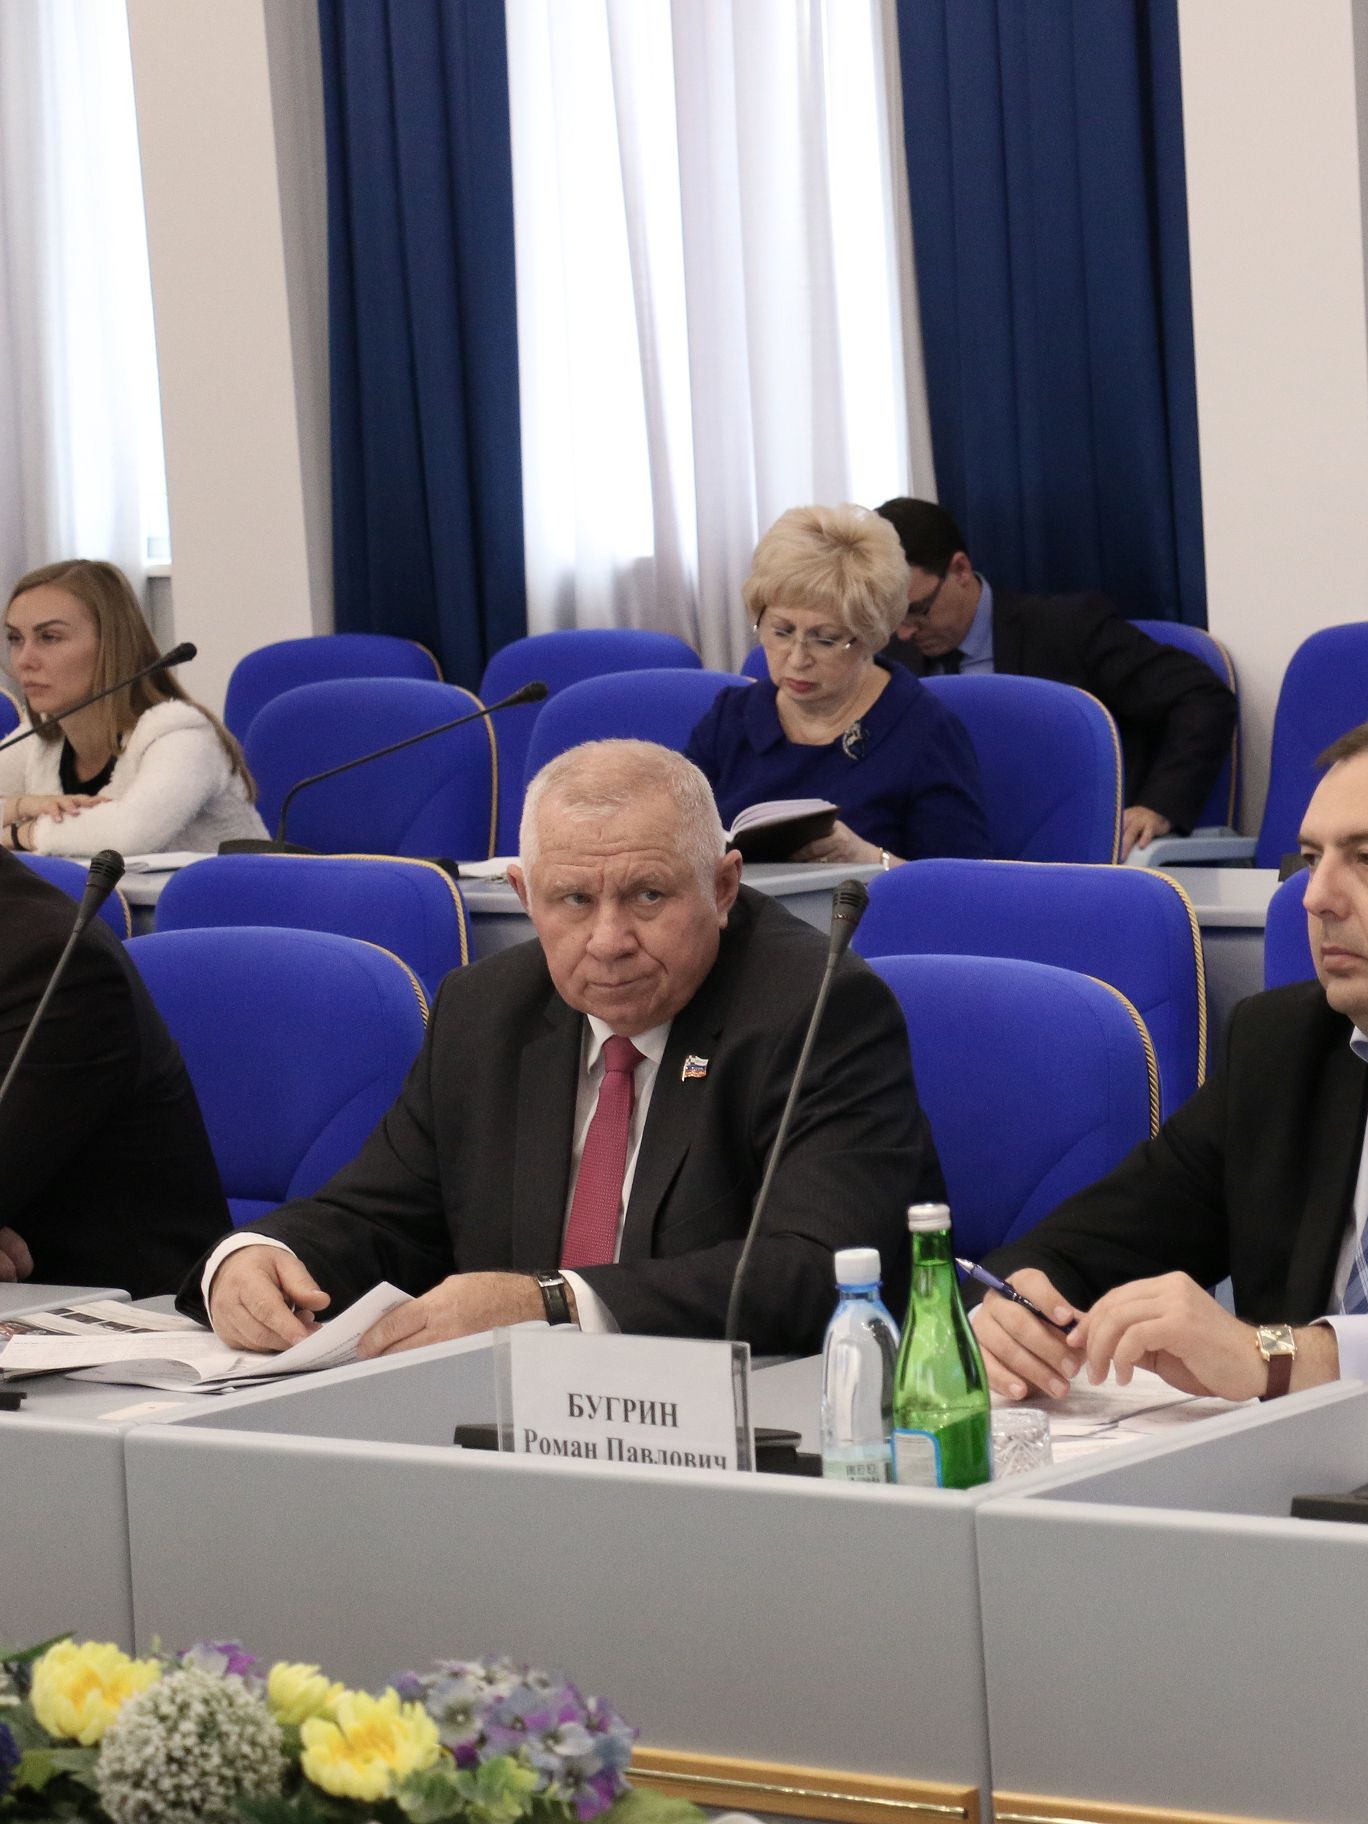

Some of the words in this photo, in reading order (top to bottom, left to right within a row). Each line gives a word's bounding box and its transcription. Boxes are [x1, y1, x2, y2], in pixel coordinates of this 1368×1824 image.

[567, 1392, 680, 1428] БУГРИН
[523, 1428, 597, 1460] Роман
[607, 1437, 727, 1470] Павлович
